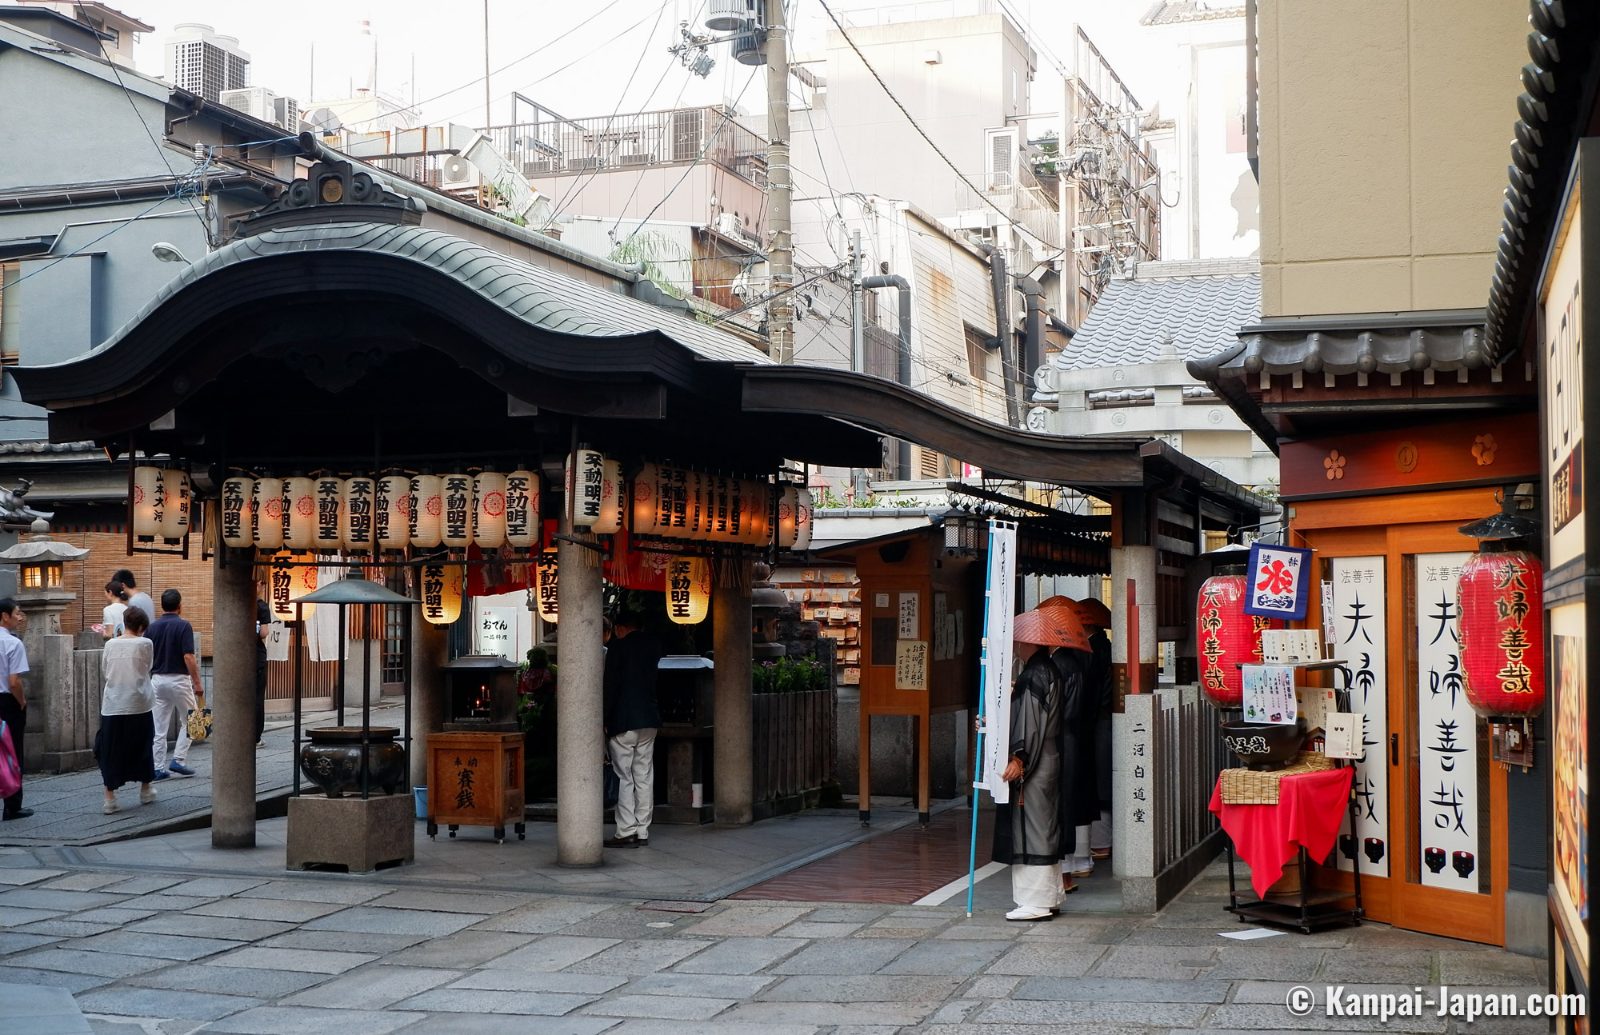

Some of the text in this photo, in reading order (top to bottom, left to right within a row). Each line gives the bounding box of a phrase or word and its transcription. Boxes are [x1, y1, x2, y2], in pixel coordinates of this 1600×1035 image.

[224, 481, 243, 539] 不動明王
[317, 480, 339, 540] 不動明王
[350, 480, 372, 542] 不動明王
[446, 477, 467, 539] 不動明王
[506, 477, 529, 537] 不動明王
[584, 452, 604, 518] 不動明王
[272, 555, 293, 614] 不動明王
[424, 565, 445, 618] 不動明王
[671, 561, 691, 618] 不動明王
[1341, 568, 1375, 584] 法善寺
[483, 618, 508, 631] おでん
[1201, 586, 1231, 691] 夫婦善哉
[1496, 561, 1533, 694] 夫婦善哉
[1427, 587, 1470, 838] 夫婦善哉
[455, 768, 476, 810] 賽銭
[1132, 722, 1147, 824] 二河白道堂
